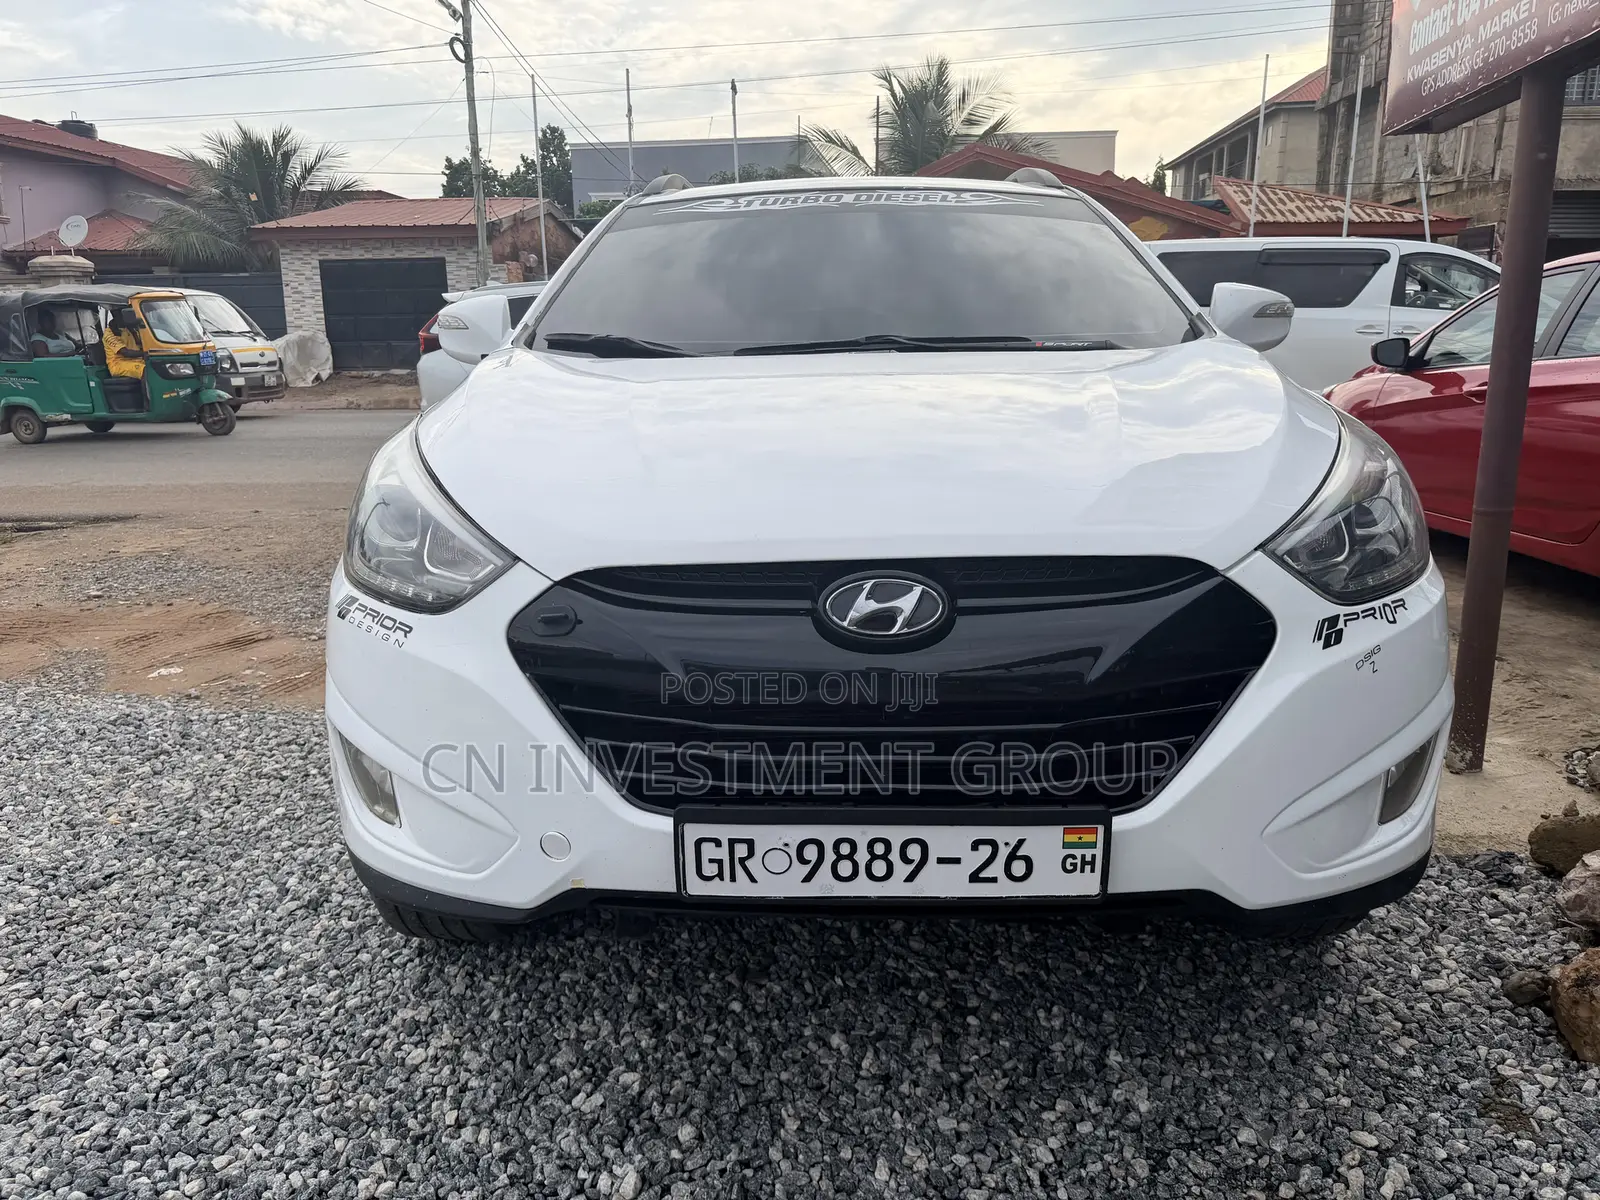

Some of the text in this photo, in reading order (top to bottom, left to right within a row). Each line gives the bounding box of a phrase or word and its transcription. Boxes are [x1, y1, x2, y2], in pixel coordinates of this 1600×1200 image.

[1421, 73, 1435, 97] GPS
[1473, 18, 1538, 70] GE-270-8558
[742, 193, 955, 208] TURBO DIESEL
[352, 602, 414, 638] PRIOR
[1343, 598, 1408, 628] PRIOR
[349, 616, 405, 648] DESIGN
[694, 837, 1034, 883] GR 9889-26
[1061, 853, 1097, 874] GH
